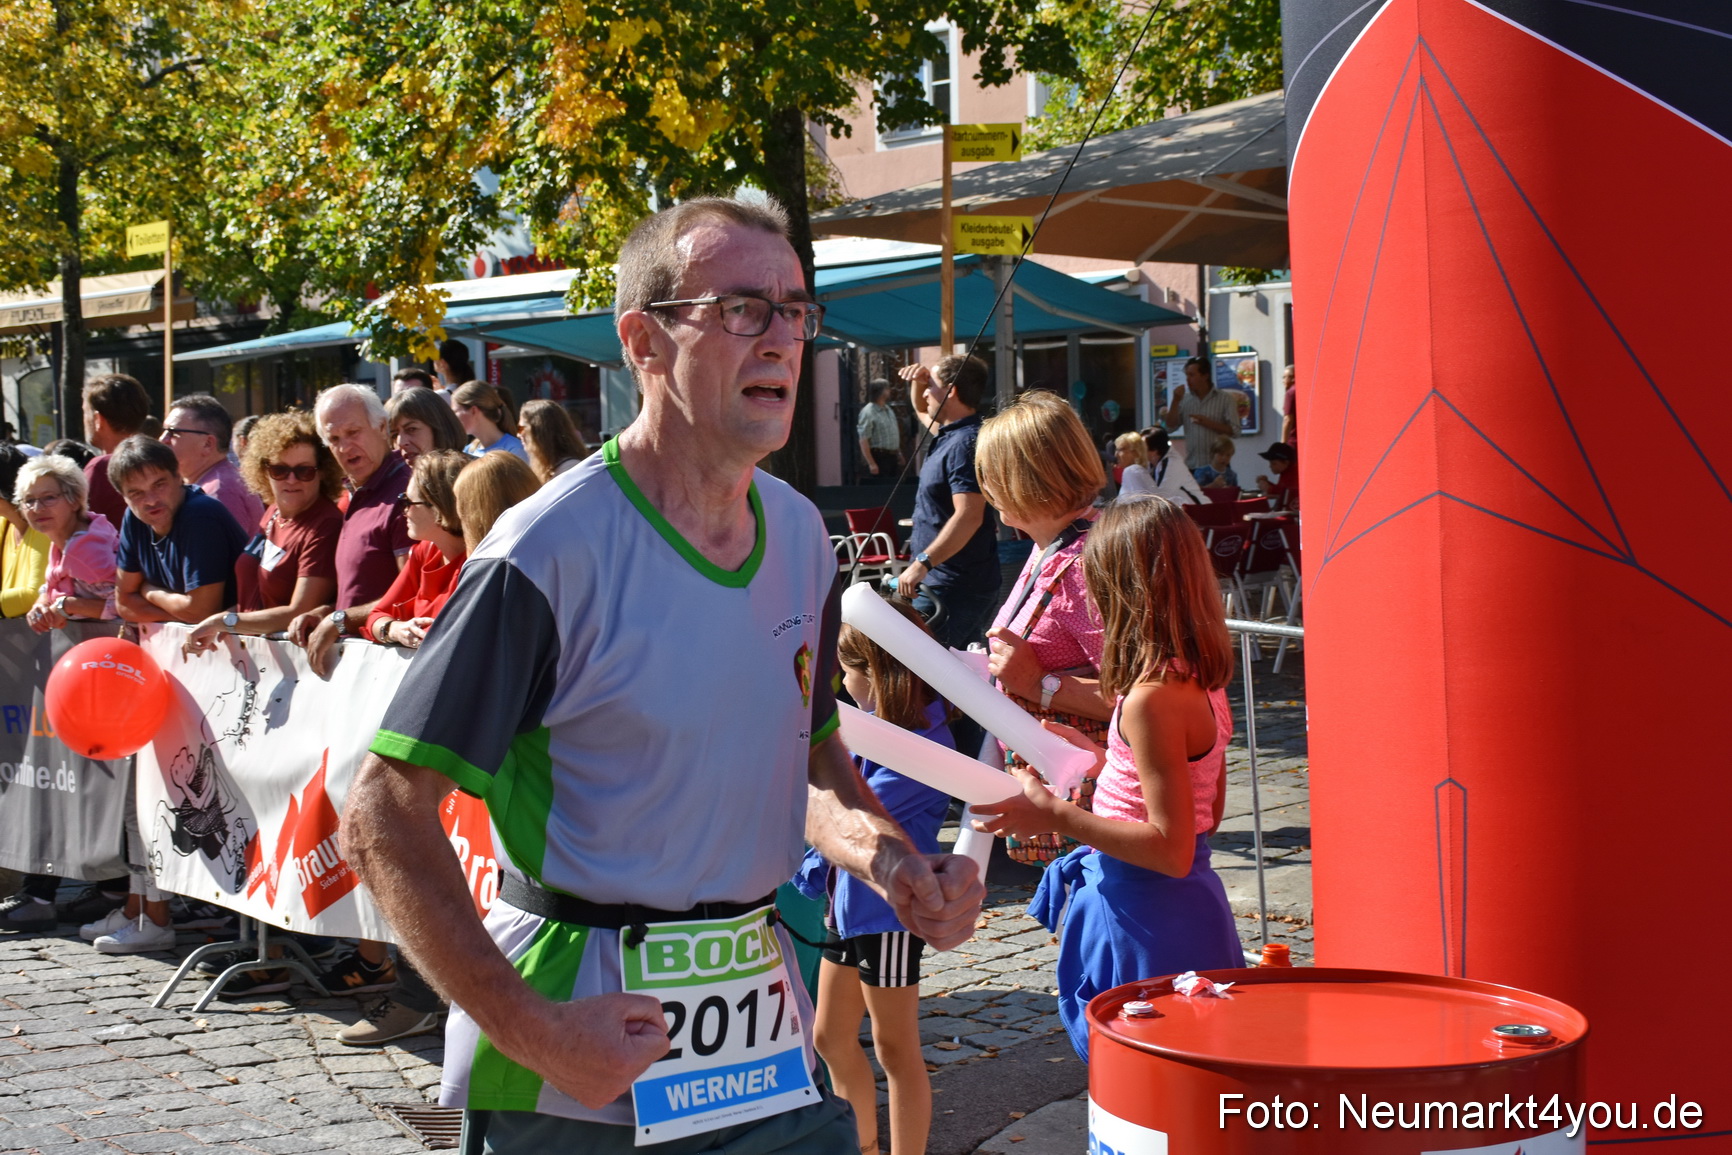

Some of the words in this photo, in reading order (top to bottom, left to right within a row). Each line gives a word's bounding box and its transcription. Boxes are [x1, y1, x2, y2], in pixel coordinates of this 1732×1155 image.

[961, 145, 995, 160] ausgabe
[960, 222, 1016, 234] Kleiderbeutel-
[134, 232, 166, 247] Toiletten
[971, 237, 1005, 249] ausgabe
[772, 616, 802, 638] RUNNING
[81, 653, 147, 682] RÖDL
[320, 872, 340, 890] Sicher
[656, 980, 785, 1062] 2017
[665, 1064, 779, 1112] WERNER
